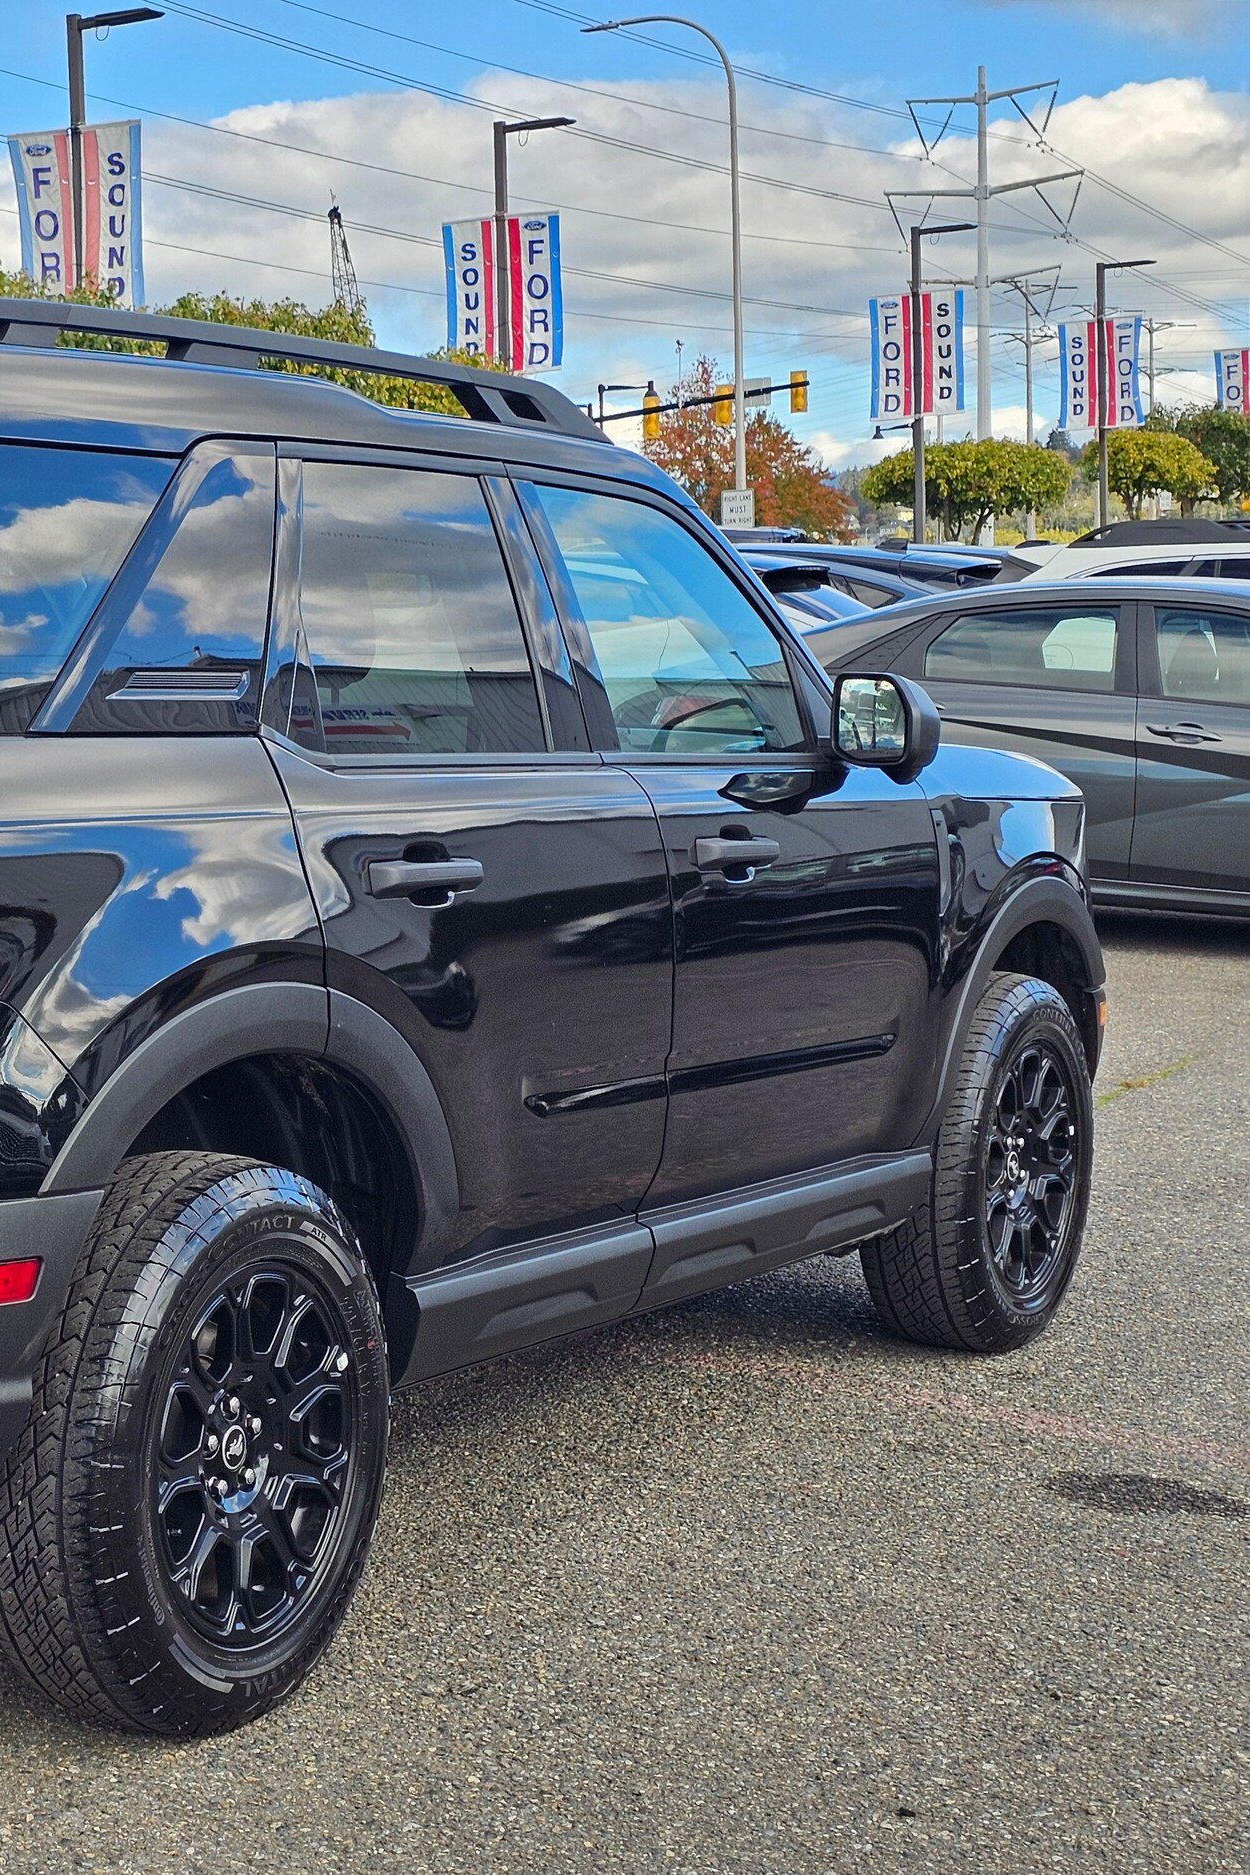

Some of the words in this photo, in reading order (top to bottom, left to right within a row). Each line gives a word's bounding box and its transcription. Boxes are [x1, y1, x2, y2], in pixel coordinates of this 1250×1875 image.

[32, 166, 61, 283] FOR
[527, 239, 550, 366] FORD
[882, 315, 901, 413] FORD
[936, 302, 953, 400] SOUND
[1071, 336, 1085, 416] SOUND
[1118, 334, 1135, 422] FORD
[1226, 364, 1241, 413] FO
[729, 505, 746, 514] MUST
[310, 1226, 329, 1242] ATR
